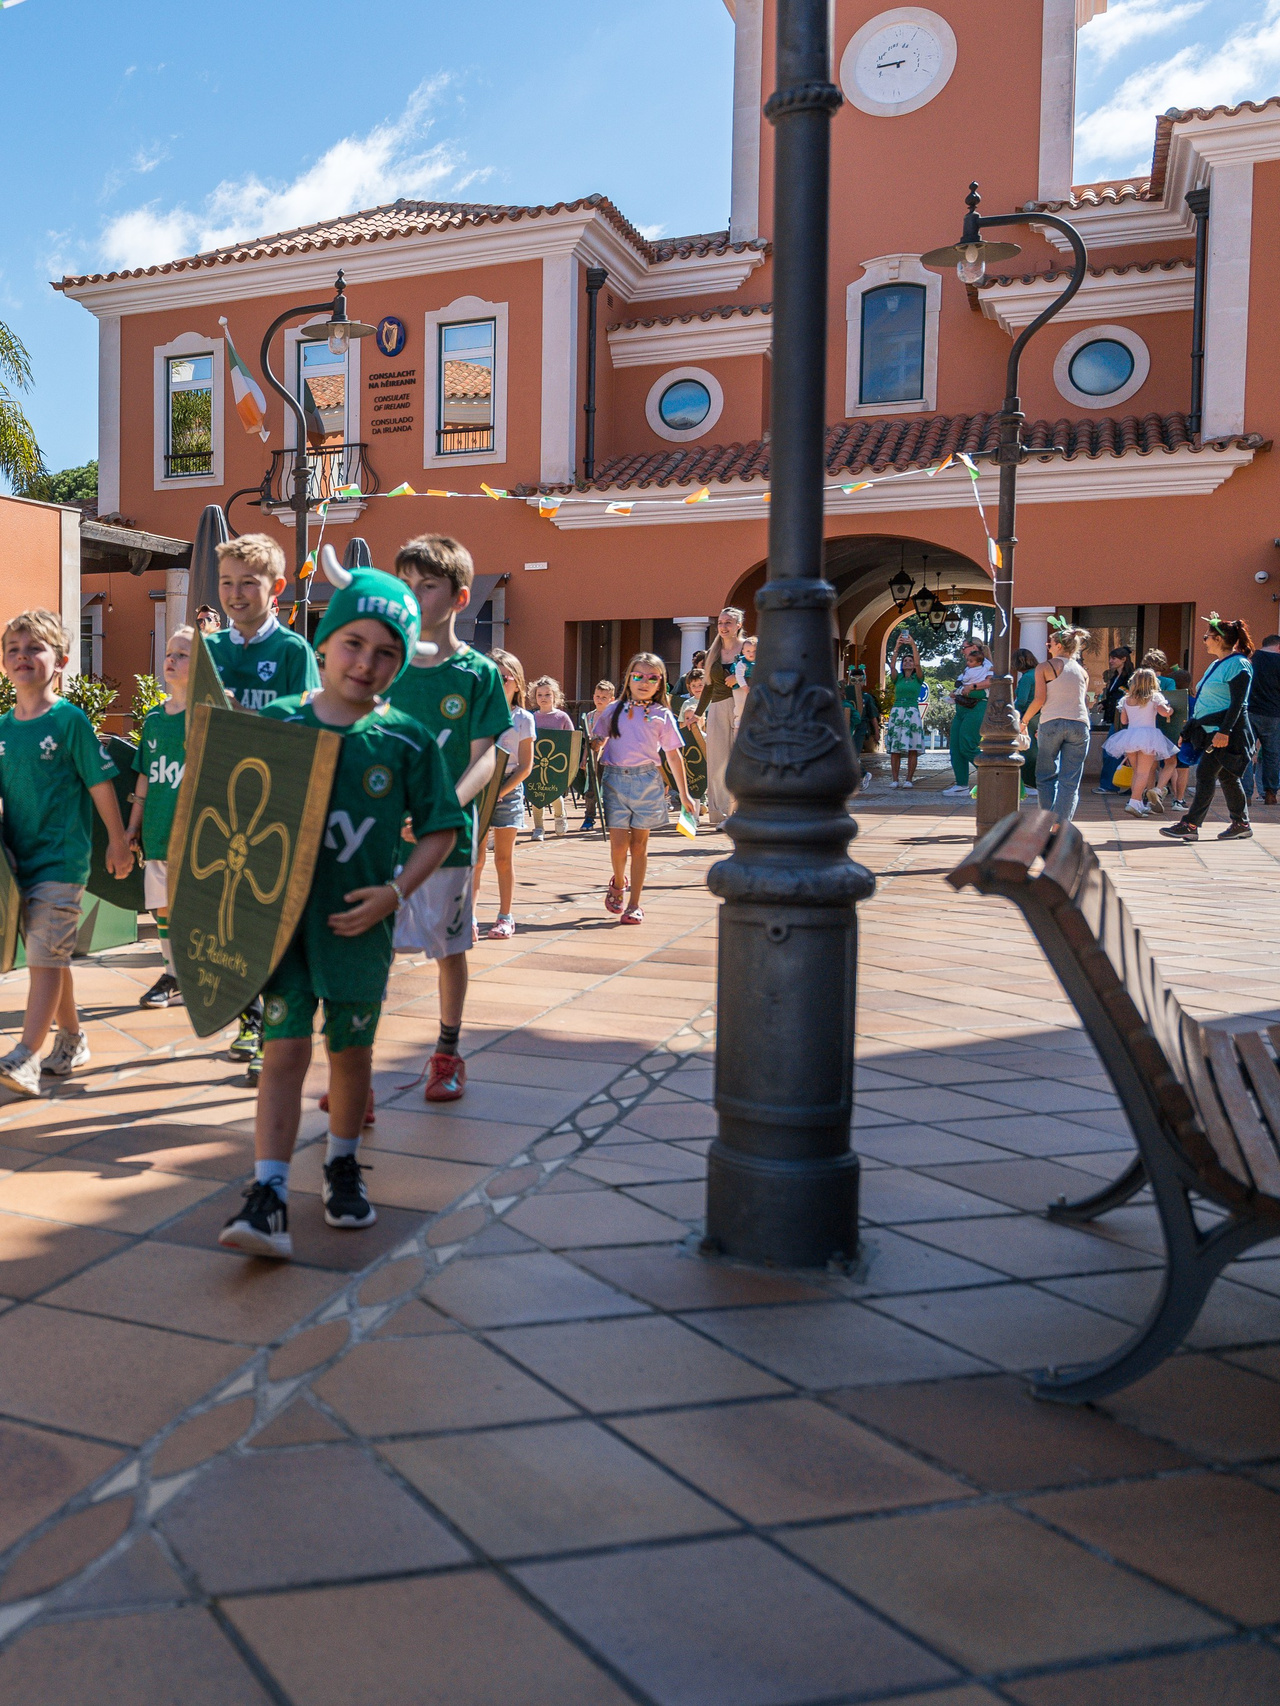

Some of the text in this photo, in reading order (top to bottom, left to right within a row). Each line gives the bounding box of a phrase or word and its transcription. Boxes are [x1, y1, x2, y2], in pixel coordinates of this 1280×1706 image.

[369, 370, 416, 381] CONSALACHT
[380, 378, 416, 388] hÉIREANN
[374, 393, 410, 403] CONSULATE
[373, 402, 410, 412] OF IRELAND
[371, 416, 413, 426] CONSULADO
[372, 425, 412, 435] DA IRLANDA
[149, 755, 186, 790] sky
